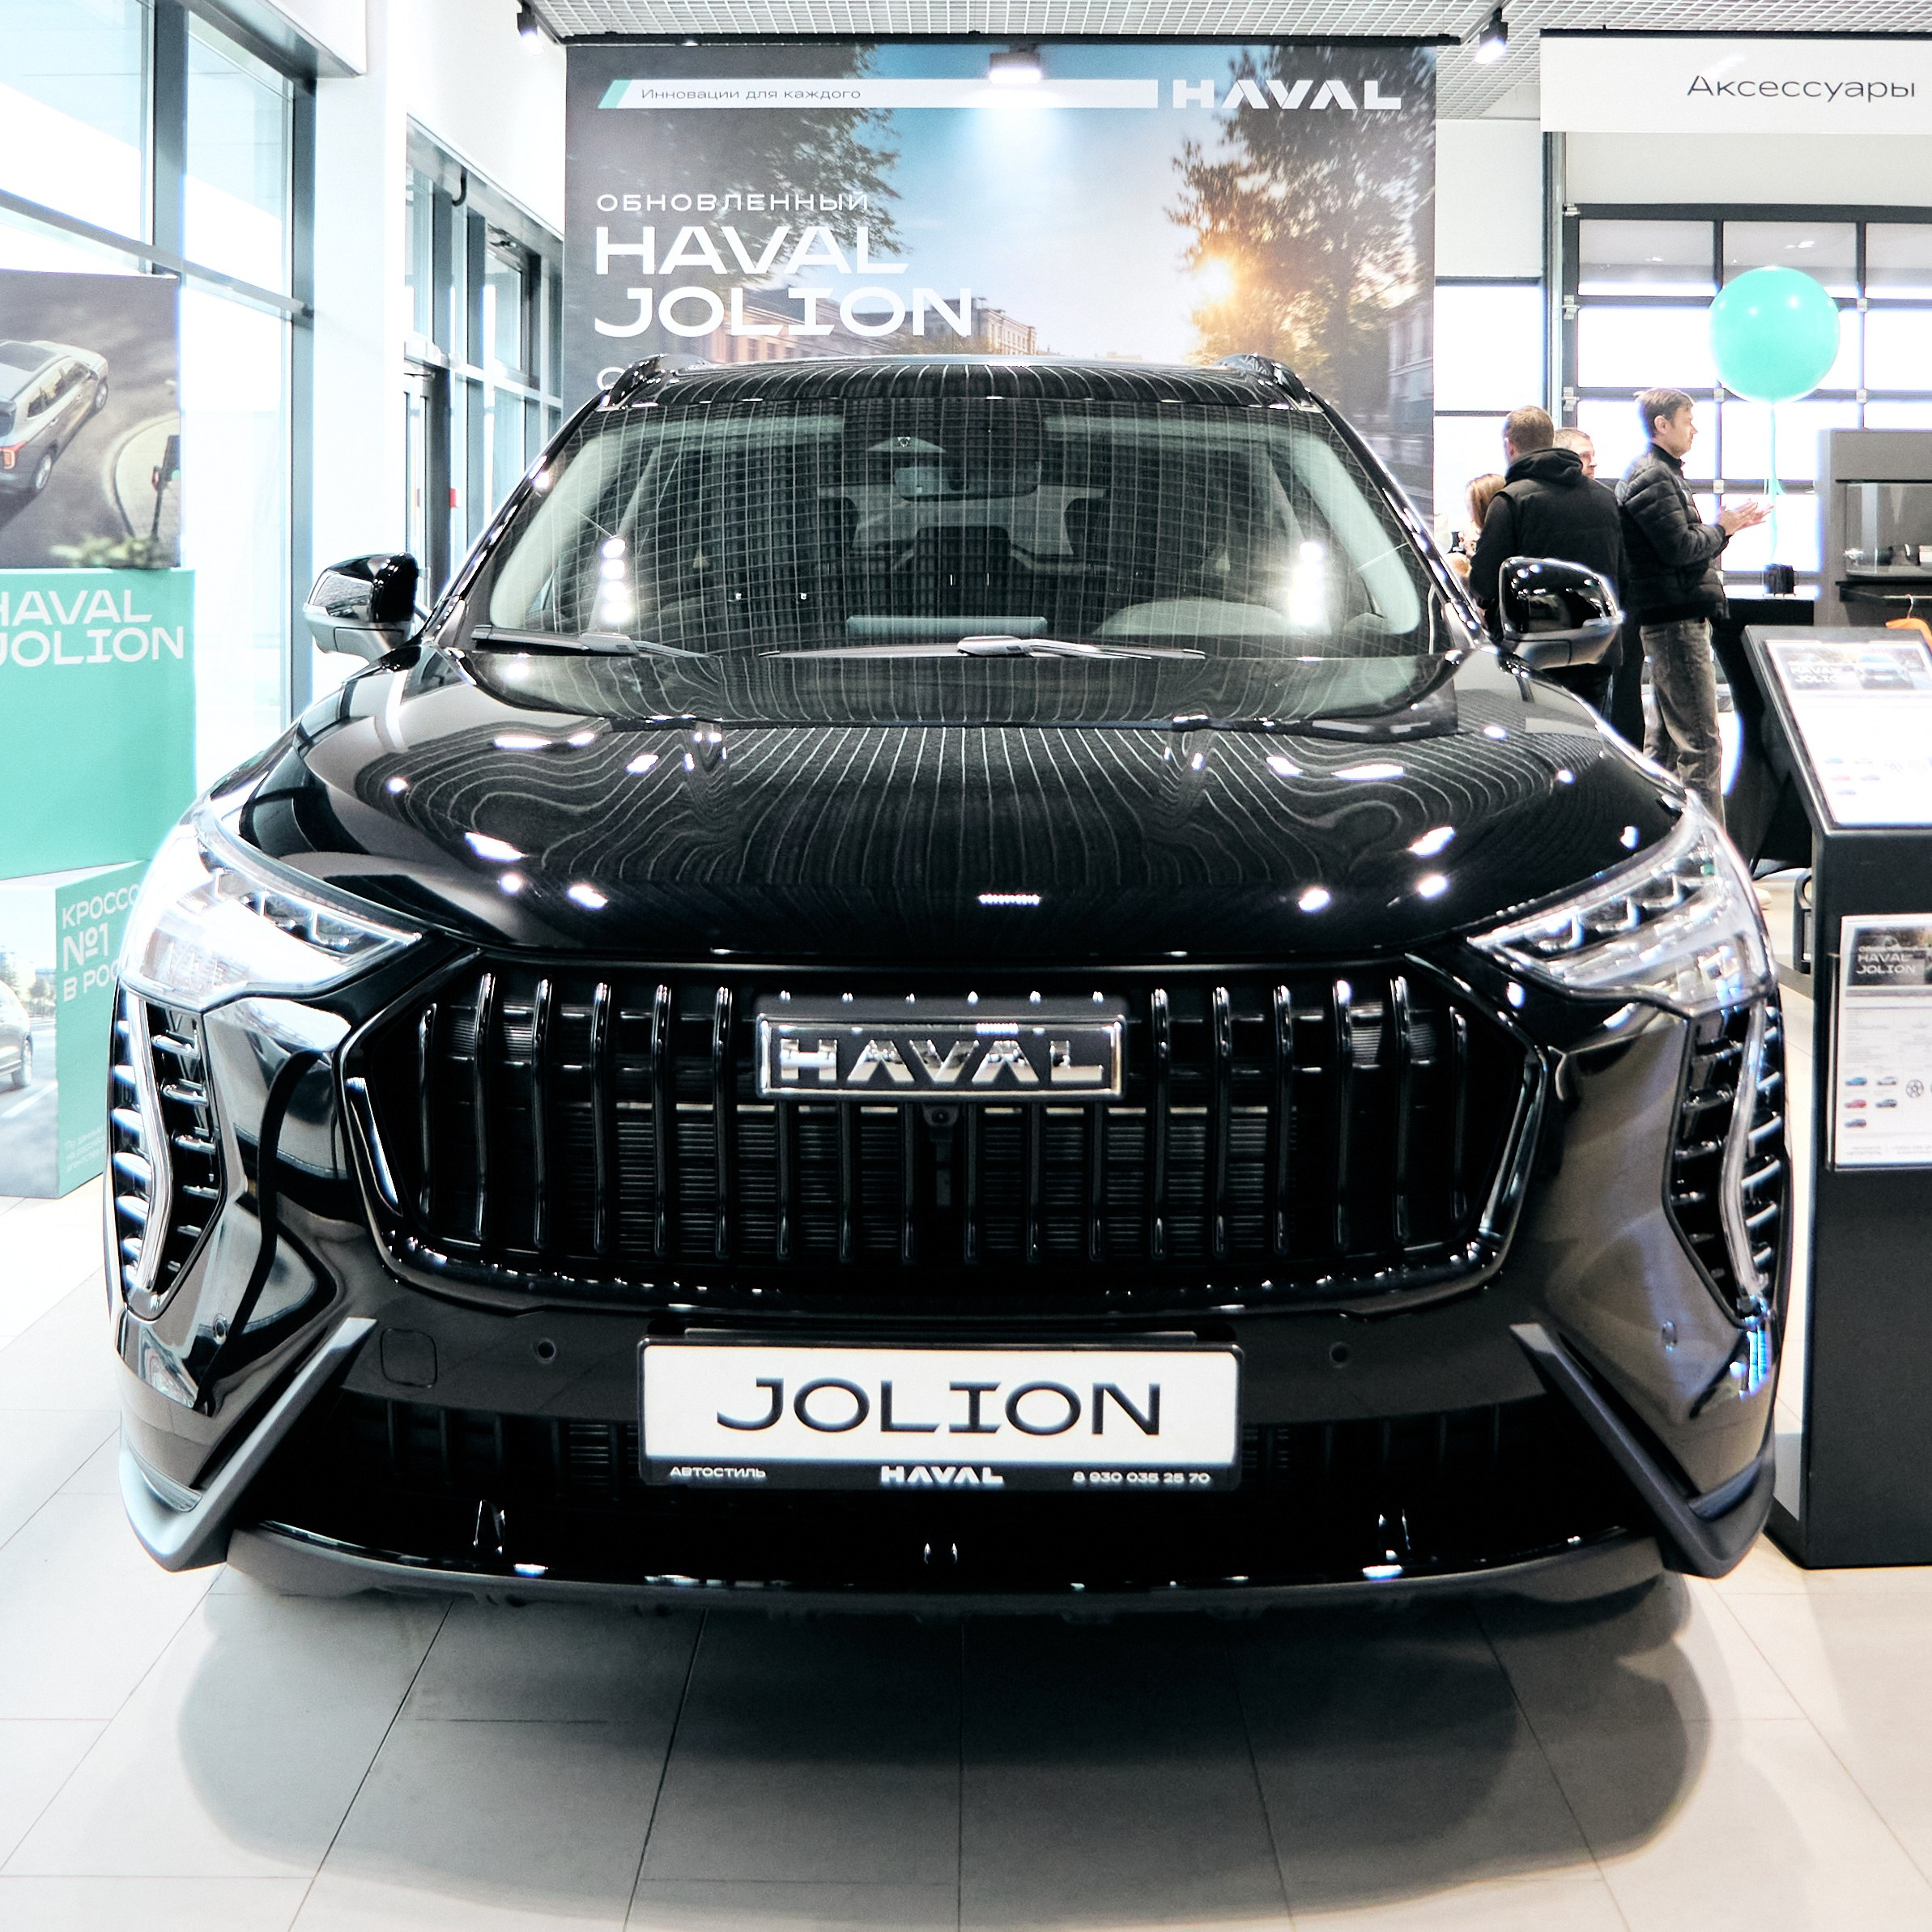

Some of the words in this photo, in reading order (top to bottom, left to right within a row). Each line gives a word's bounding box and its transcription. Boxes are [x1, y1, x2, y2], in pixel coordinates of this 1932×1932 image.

[641, 89, 739, 100] Инновации
[746, 90, 777, 100] для
[784, 90, 862, 100] каждого
[1172, 79, 1402, 110] HAVAL
[1687, 74, 1916, 103] Аксессуары
[597, 189, 869, 212] ОБНОВЛЕННЫЙ
[594, 225, 909, 275] HAVAL
[594, 286, 972, 338] JOLION
[63, 922, 109, 972] №1
[1858, 953, 1909, 963] HAVAL
[1856, 964, 1916, 974] JOLION
[63, 976, 78, 1002] В
[780, 1039, 1104, 1083] HAVAL
[717, 1377, 1160, 1436] JOLION
[670, 1466, 766, 1479] АВТОСТИЛЬ
[880, 1465, 1004, 1485] HAVAL
[1073, 1471, 1085, 1483] 8
[1089, 1471, 1123, 1483] 930
[1126, 1472, 1160, 1483] 035
[1164, 1472, 1185, 1483] 25
[1189, 1472, 1211, 1483] 70
